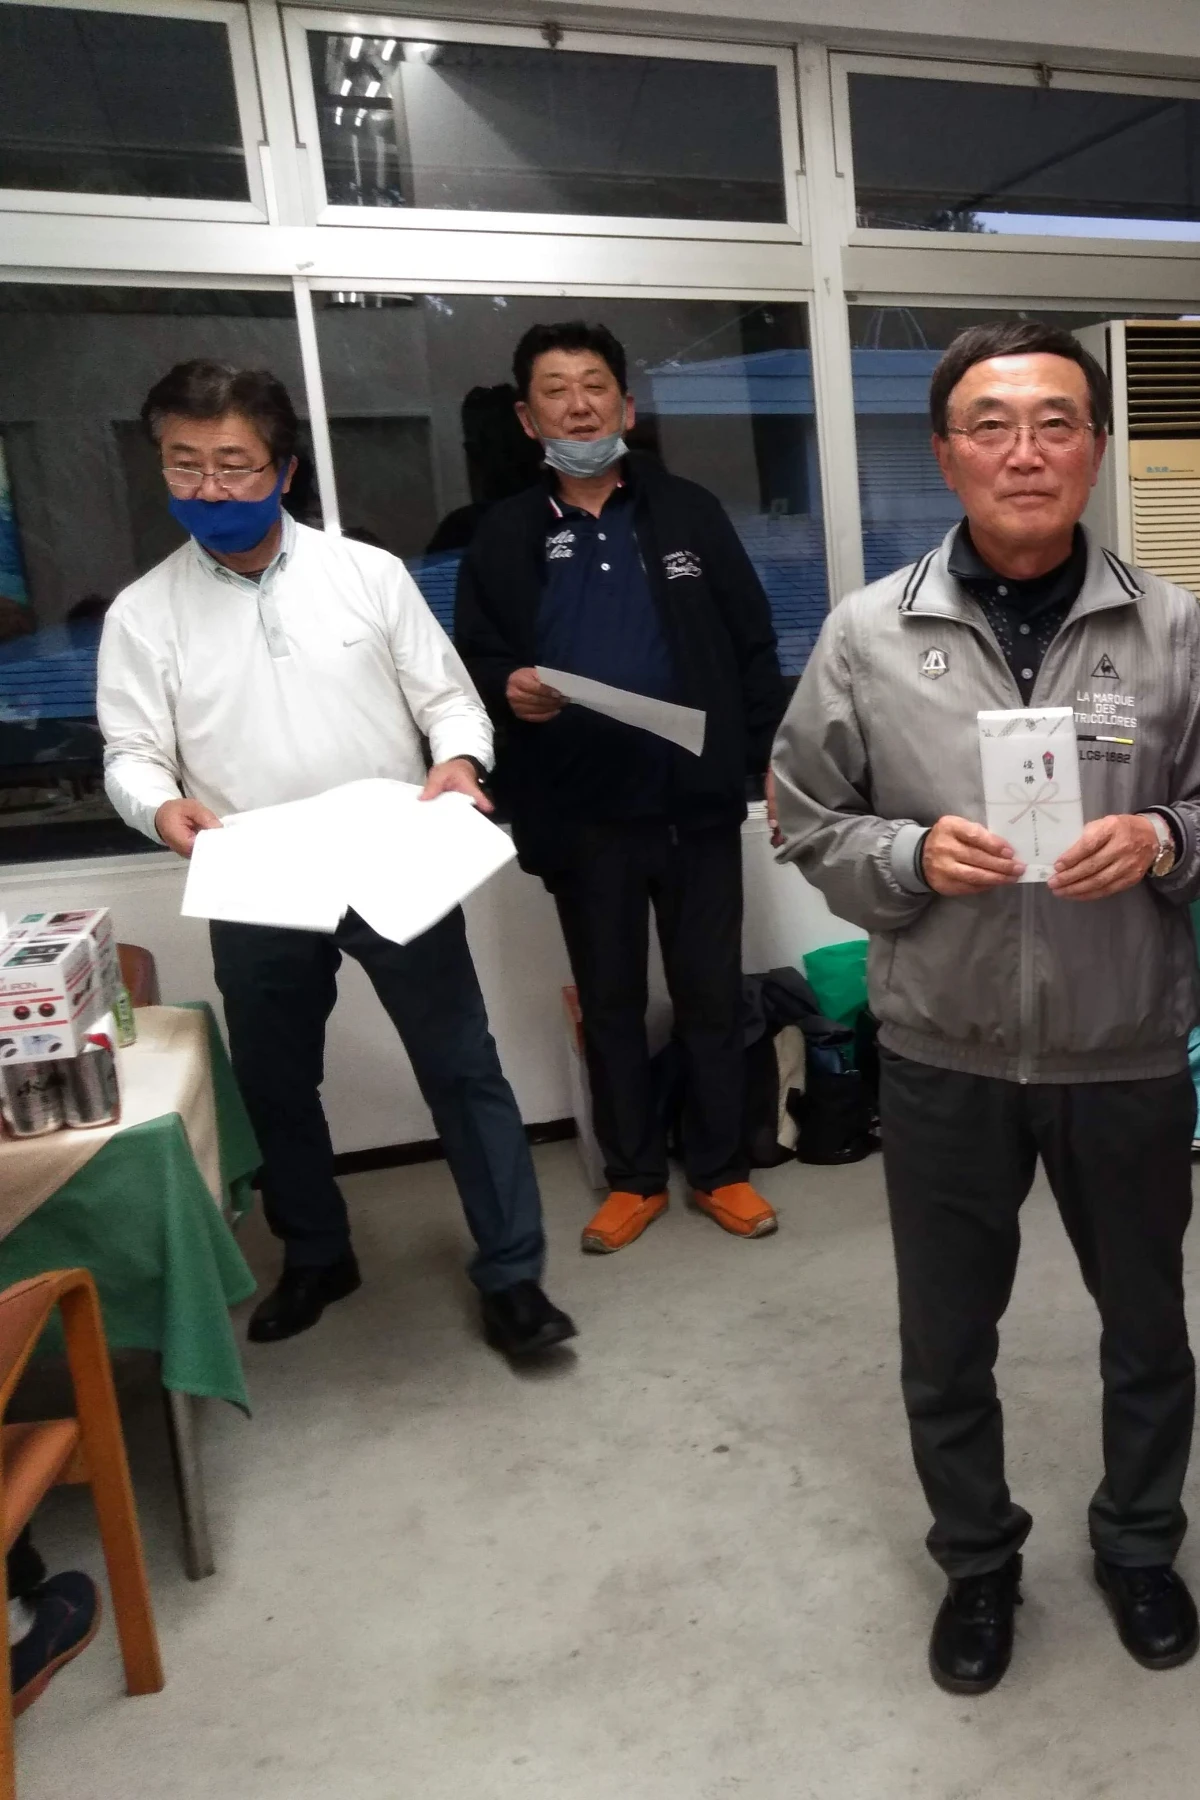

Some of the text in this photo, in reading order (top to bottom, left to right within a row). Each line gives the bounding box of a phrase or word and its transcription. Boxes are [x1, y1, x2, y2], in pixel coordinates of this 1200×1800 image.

[1076, 690, 1136, 707] LA MARQUE
[1095, 703, 1117, 714] DES
[1073, 712, 1138, 728] TRICOLORES
[1022, 759, 1036, 785] 優勝
